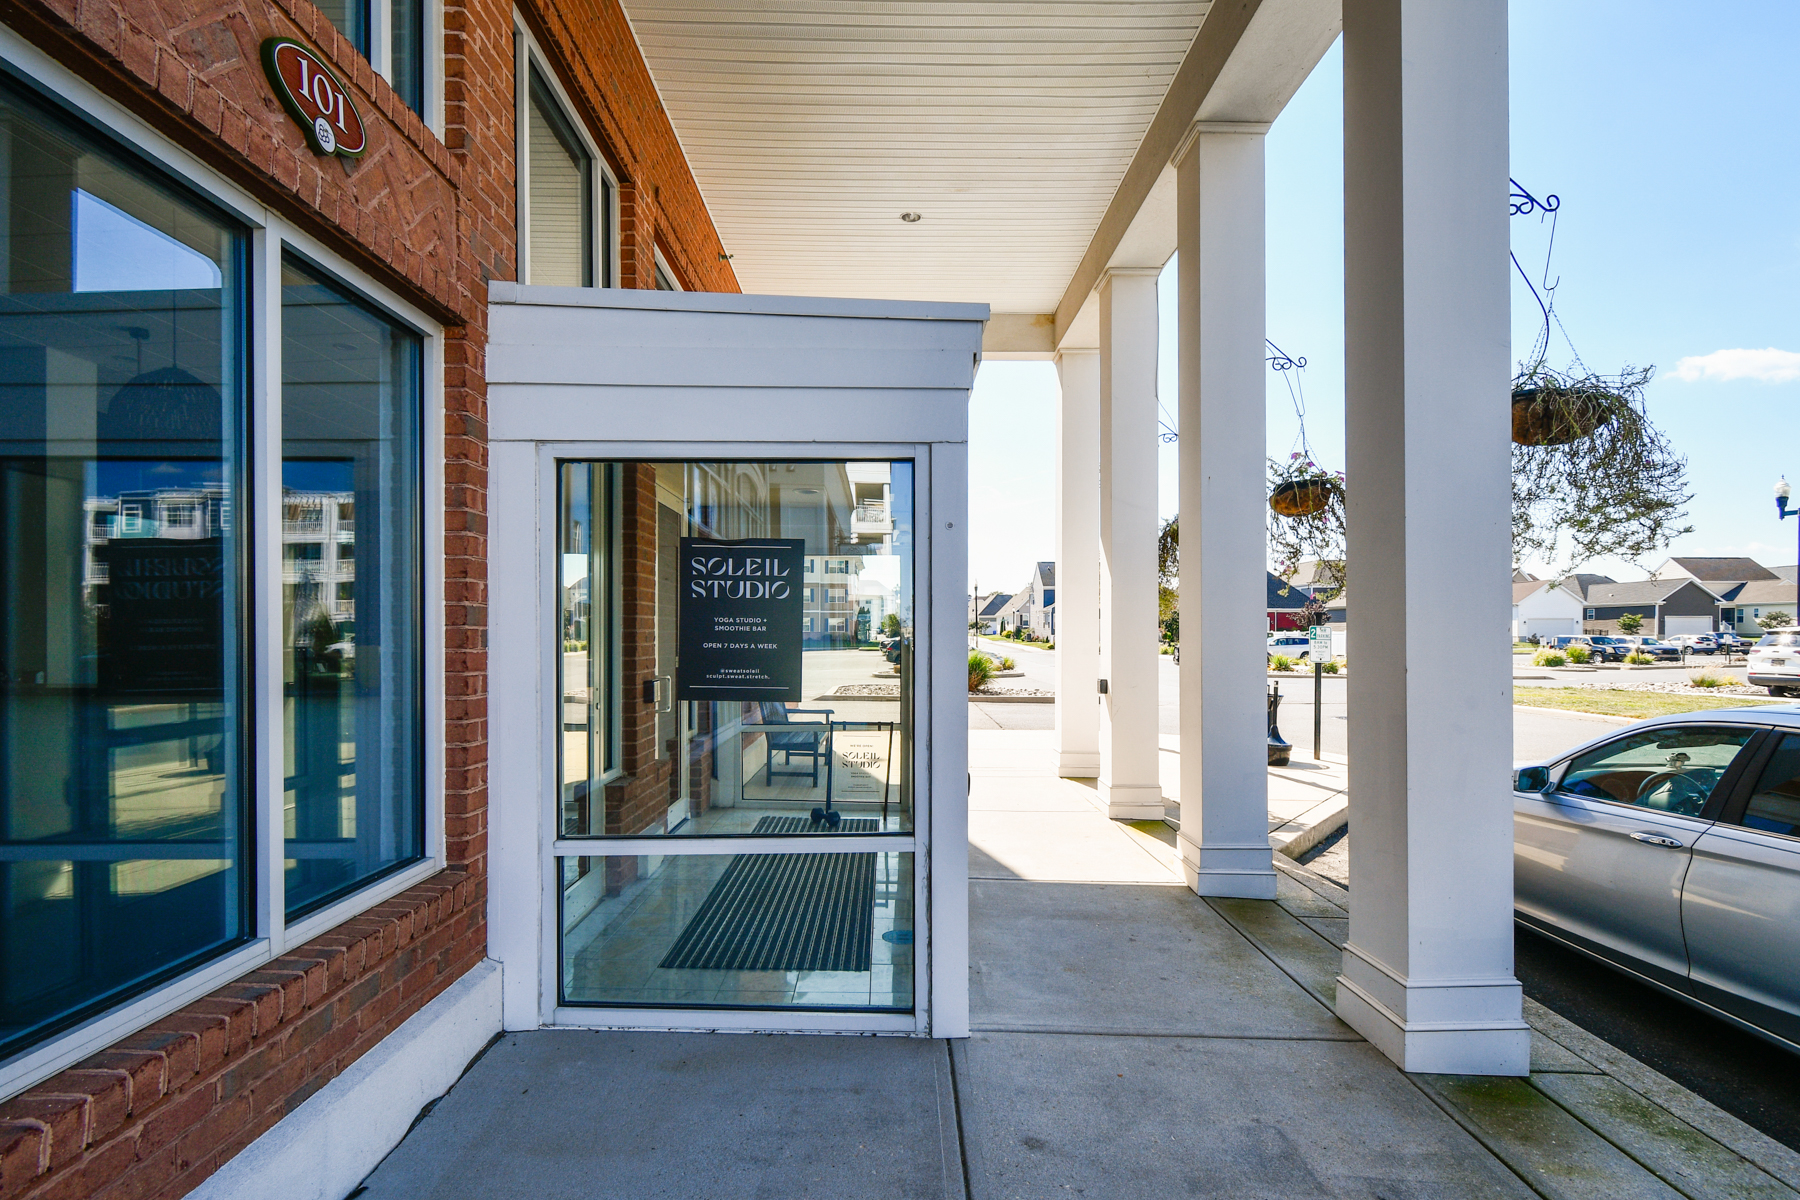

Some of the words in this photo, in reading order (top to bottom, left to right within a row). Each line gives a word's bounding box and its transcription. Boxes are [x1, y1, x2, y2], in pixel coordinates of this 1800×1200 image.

[297, 56, 348, 134] 101
[692, 557, 790, 576] SOLEIL
[691, 580, 790, 600] STUDIO
[1311, 629, 1316, 638] 2
